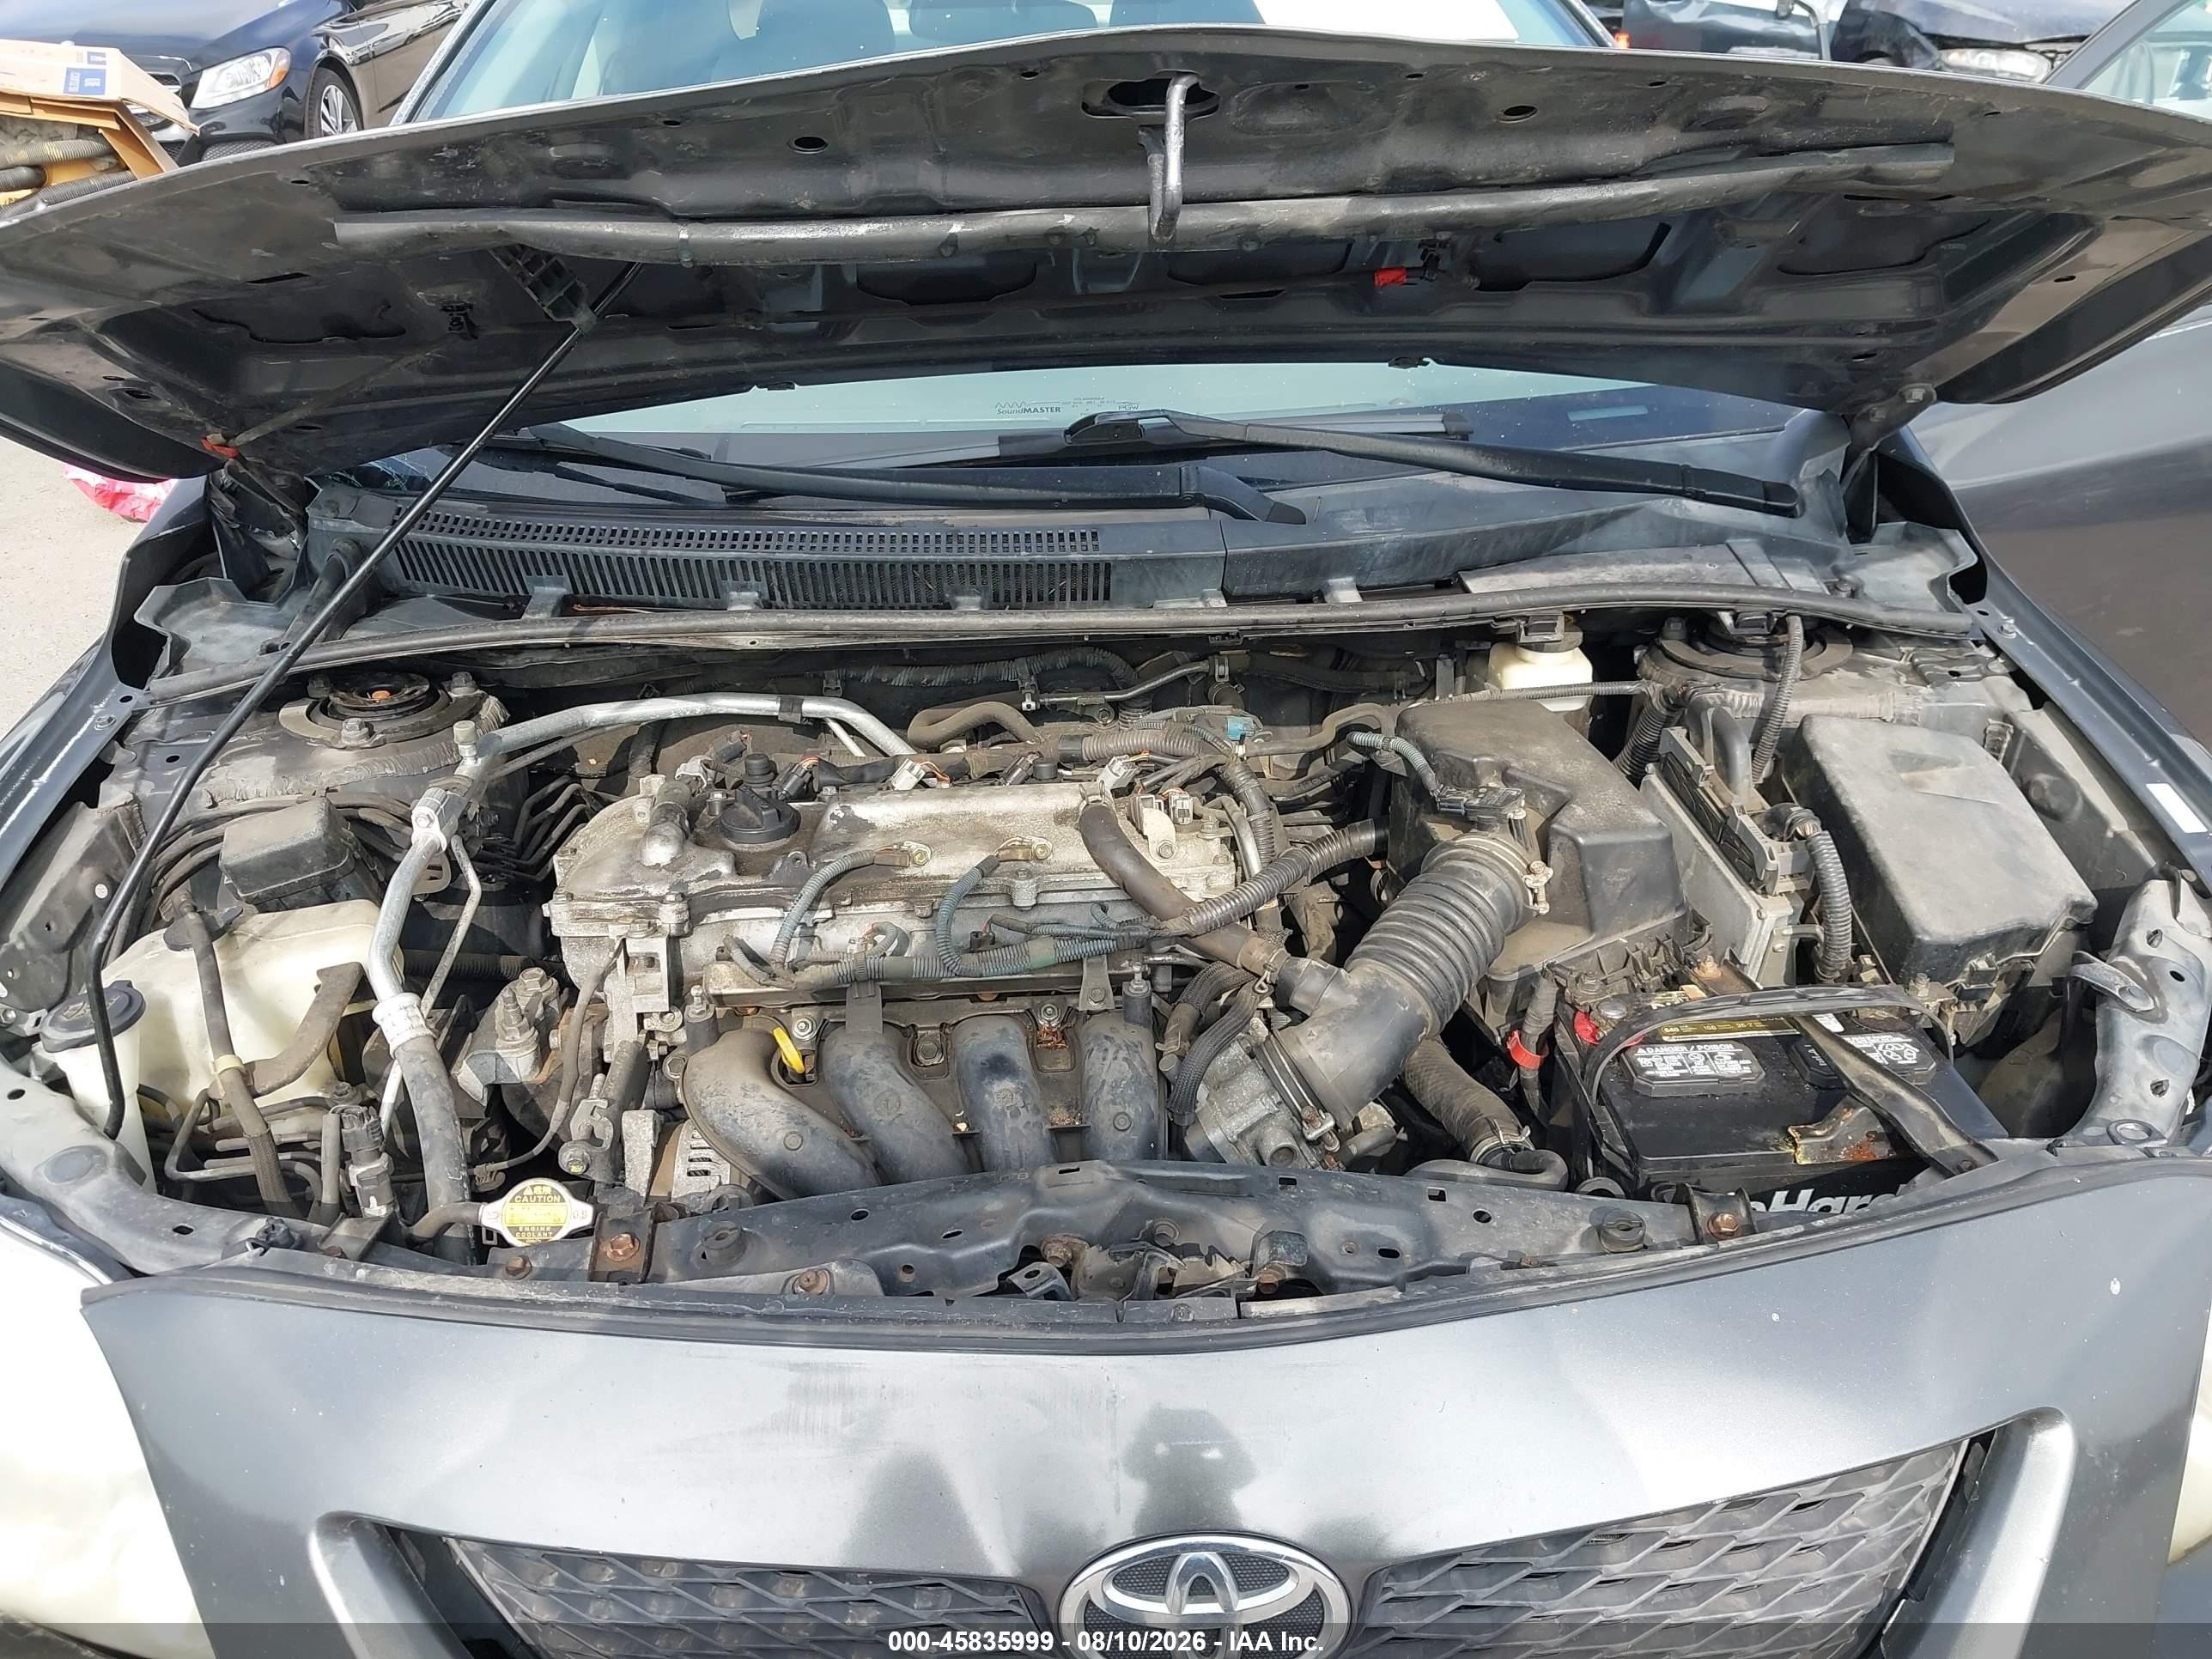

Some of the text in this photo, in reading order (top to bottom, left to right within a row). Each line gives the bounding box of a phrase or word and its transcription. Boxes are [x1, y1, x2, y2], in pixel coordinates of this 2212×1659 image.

[996, 406, 1061, 415] SoundMASTER
[1646, 1044, 1689, 1054] DANGER
[514, 1194, 561, 1203] CAUTION
